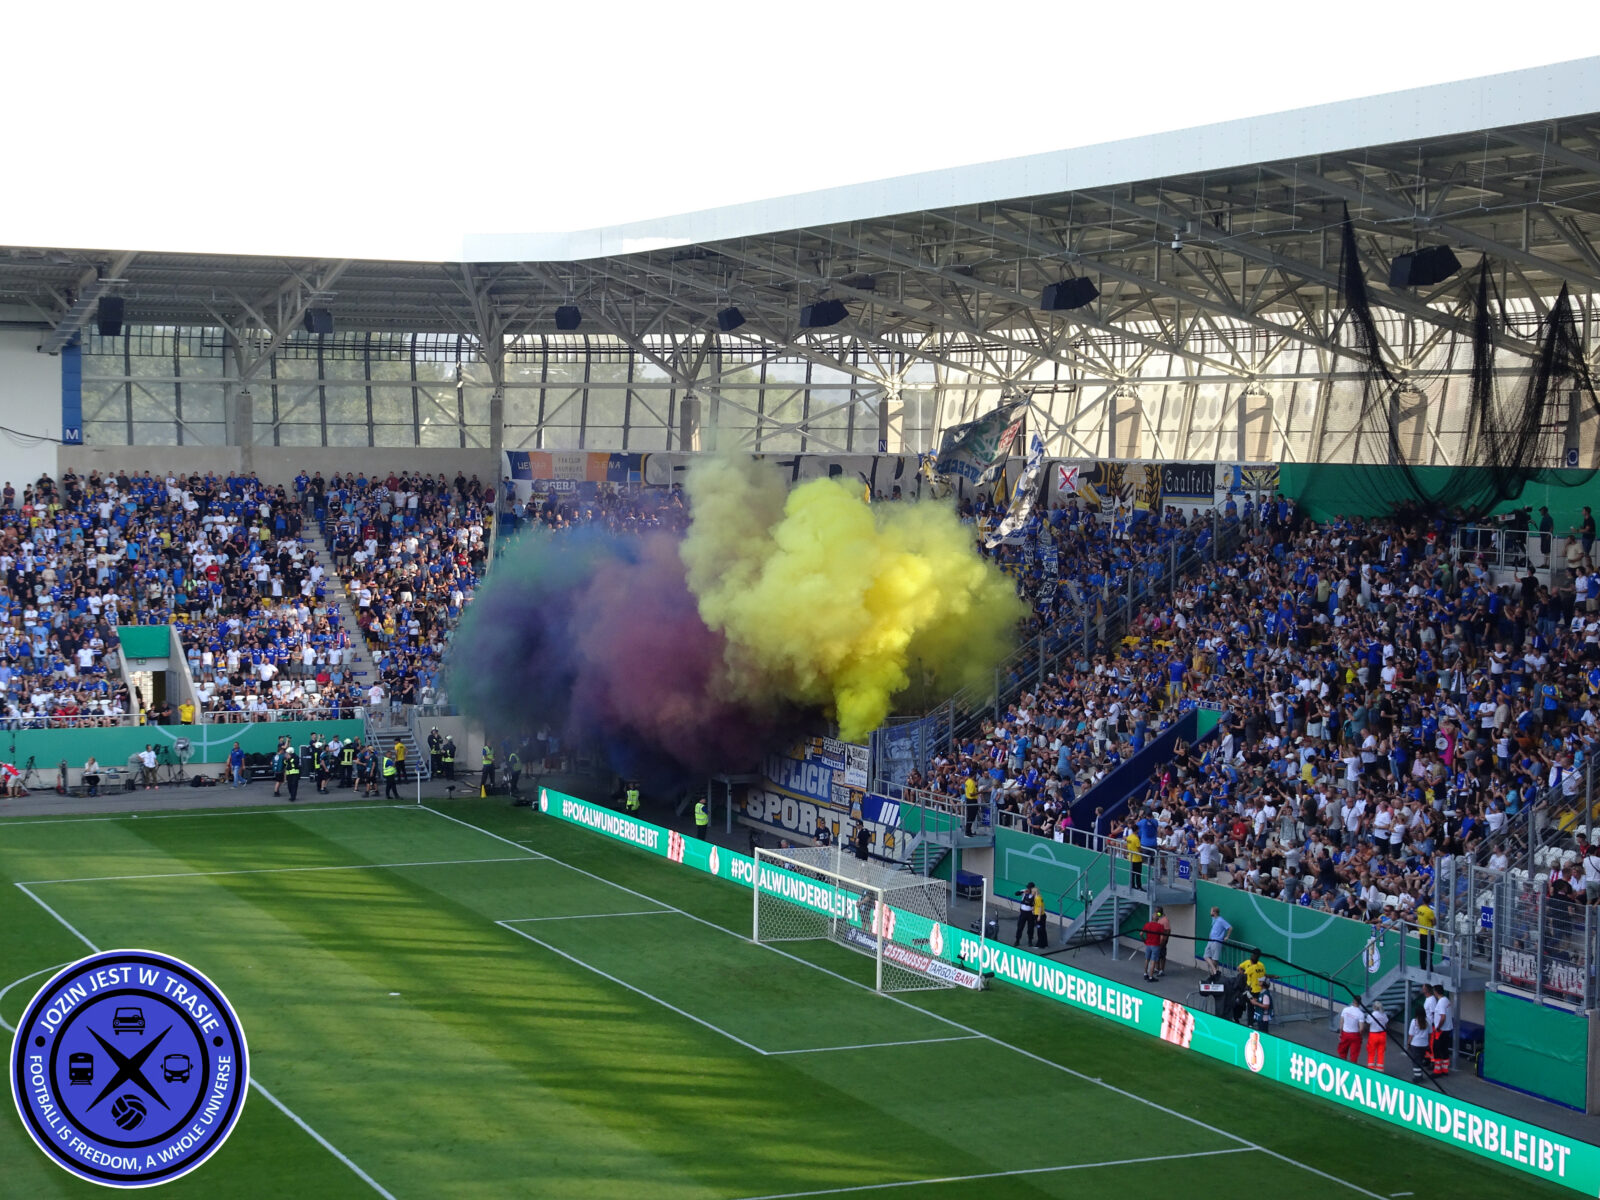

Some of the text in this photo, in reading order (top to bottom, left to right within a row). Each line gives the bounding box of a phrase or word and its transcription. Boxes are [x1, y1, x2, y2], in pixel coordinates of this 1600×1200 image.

[65, 429, 79, 440] M
[879, 440, 887, 452] N
[1164, 468, 1213, 494] Saalfeld
[562, 799, 659, 849] #POKALWUNDERBLEIBT
[1179, 865, 1189, 874] C17
[890, 946, 922, 968] STRAUSS
[960, 937, 1143, 1024] #POKALWUNDERBLEIBT
[1290, 1052, 1571, 1177] #POKALWUNDERBLEIBT
